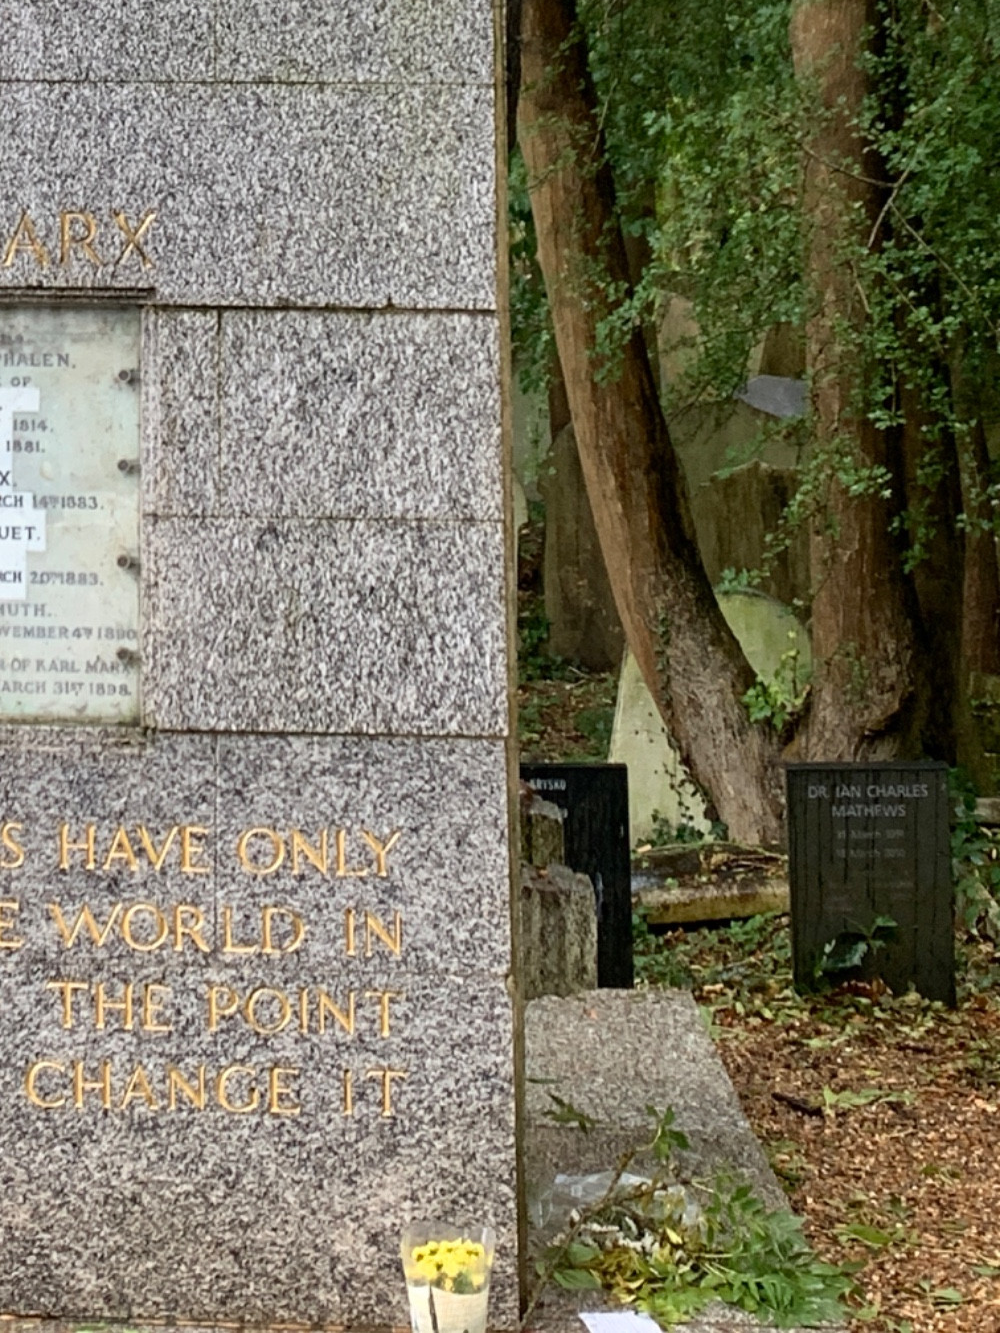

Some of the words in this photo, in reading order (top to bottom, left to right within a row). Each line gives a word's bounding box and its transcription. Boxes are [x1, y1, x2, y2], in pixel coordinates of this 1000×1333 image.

[10, 376, 32, 387] OF
[12, 420, 55, 432] 1814.
[5, 440, 46, 453] 1881.
[12, 658, 30, 672] OF
[36, 659, 80, 673] KARL
[836, 785, 861, 798] IAN
[867, 784, 928, 798] CHARLES
[831, 805, 906, 818] MATHEWS
[58, 820, 209, 875] HAVE
[236, 825, 401, 880] ONLY
[48, 900, 308, 957] WORLD
[343, 907, 403, 958] IN
[46, 979, 172, 1034] THE
[205, 984, 404, 1039] POINT
[22, 1059, 302, 1117] CHANGE
[342, 1066, 410, 1119] IT
